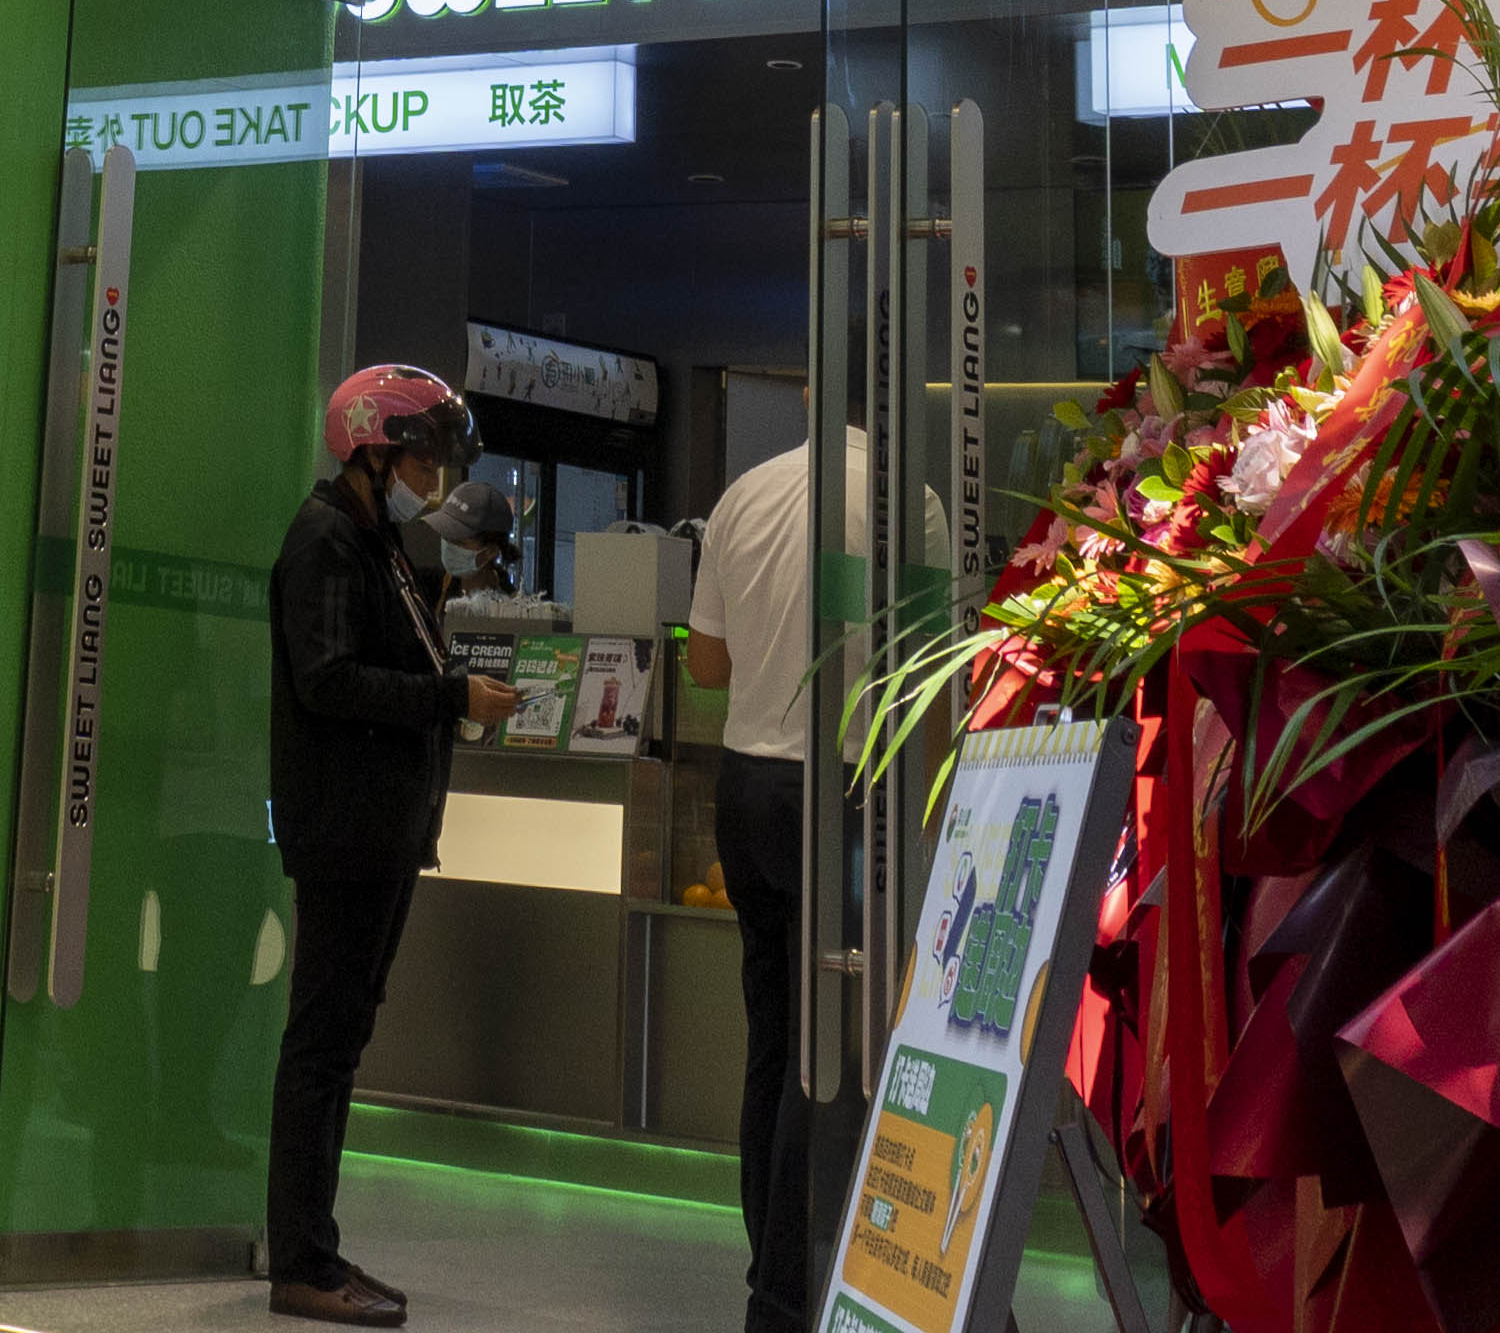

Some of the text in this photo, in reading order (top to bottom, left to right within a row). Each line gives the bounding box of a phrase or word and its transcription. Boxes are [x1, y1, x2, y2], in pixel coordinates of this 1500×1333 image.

[488, 79, 567, 128] 取茶
[87, 307, 121, 552] SWEET LIANG
[963, 292, 982, 578] SWEET LIANG
[69, 574, 105, 829] SWEET LIANG
[471, 644, 513, 657] CREAM
